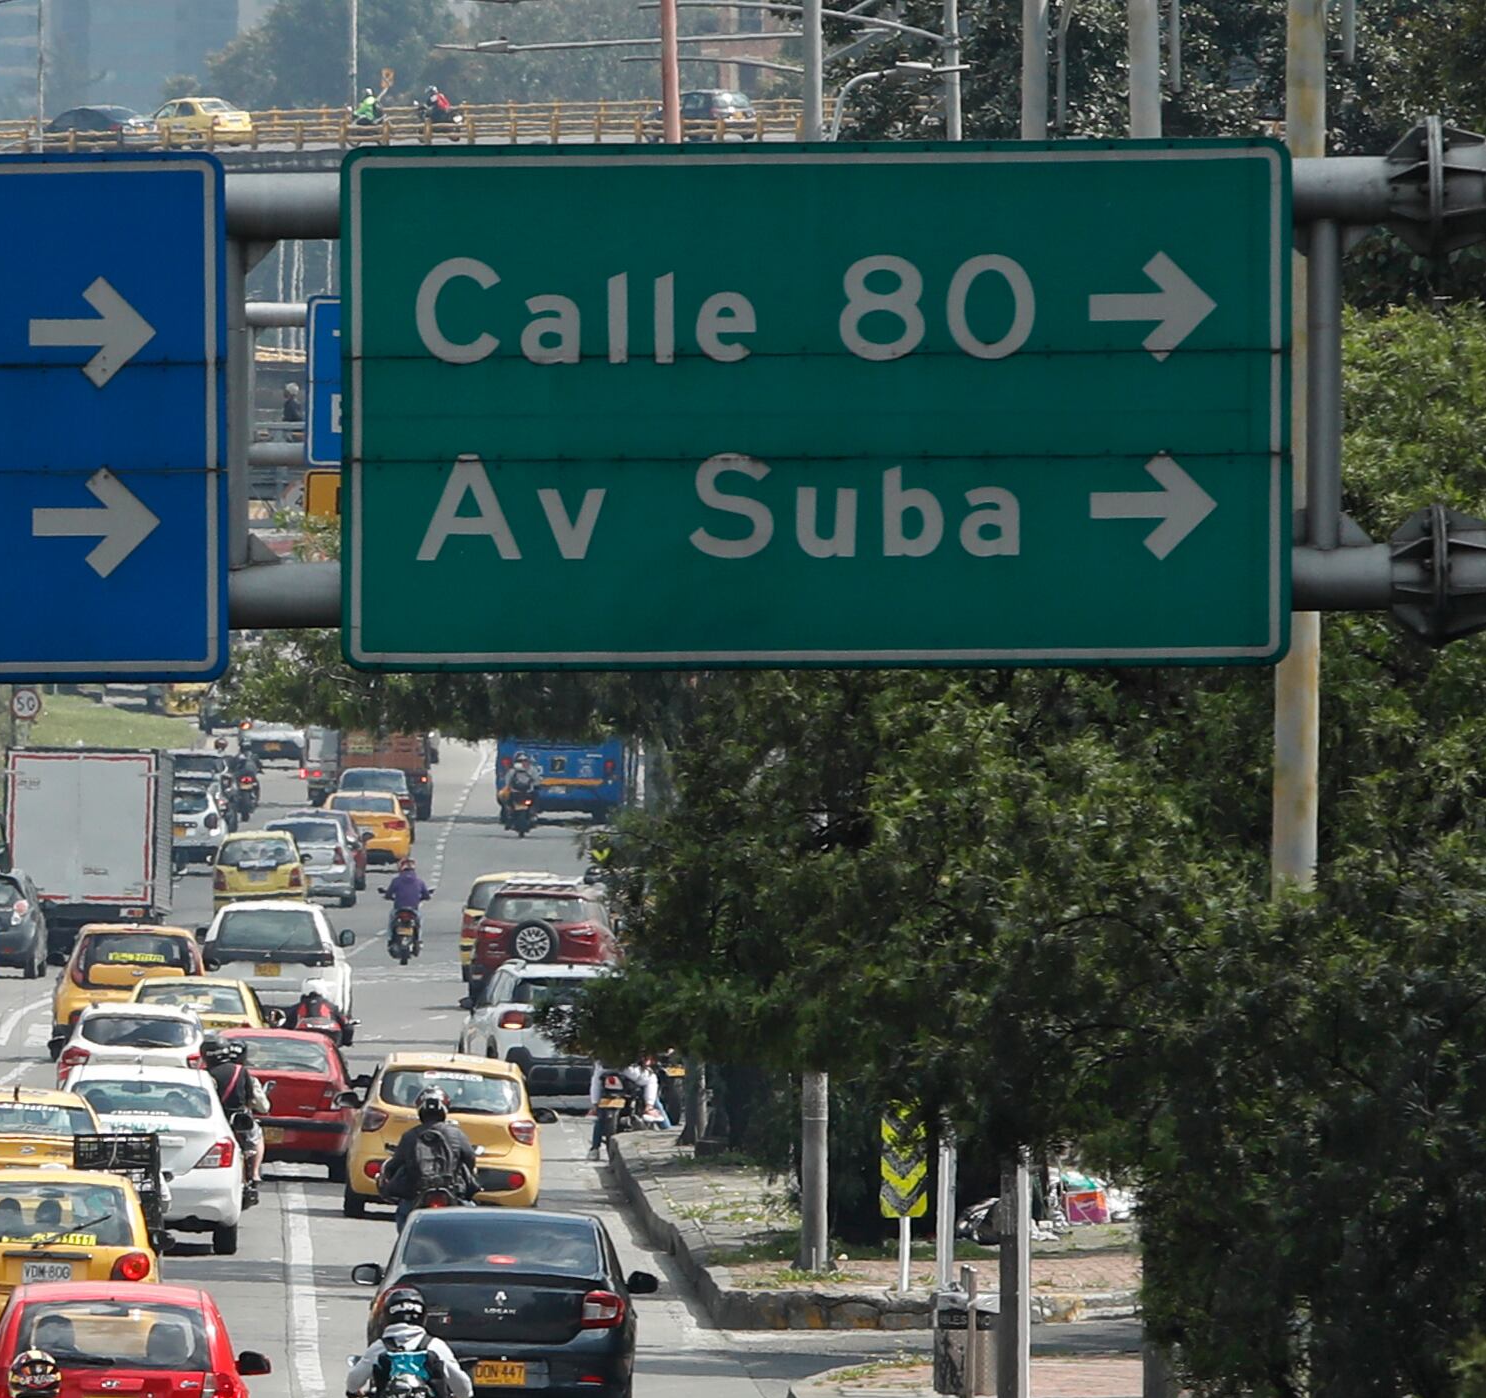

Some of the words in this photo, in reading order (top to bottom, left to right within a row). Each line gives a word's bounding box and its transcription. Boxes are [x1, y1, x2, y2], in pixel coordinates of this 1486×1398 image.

[415, 256, 757, 365] Calle
[837, 254, 1036, 362] 80
[415, 453, 606, 561] Av
[689, 453, 1022, 560] Suba
